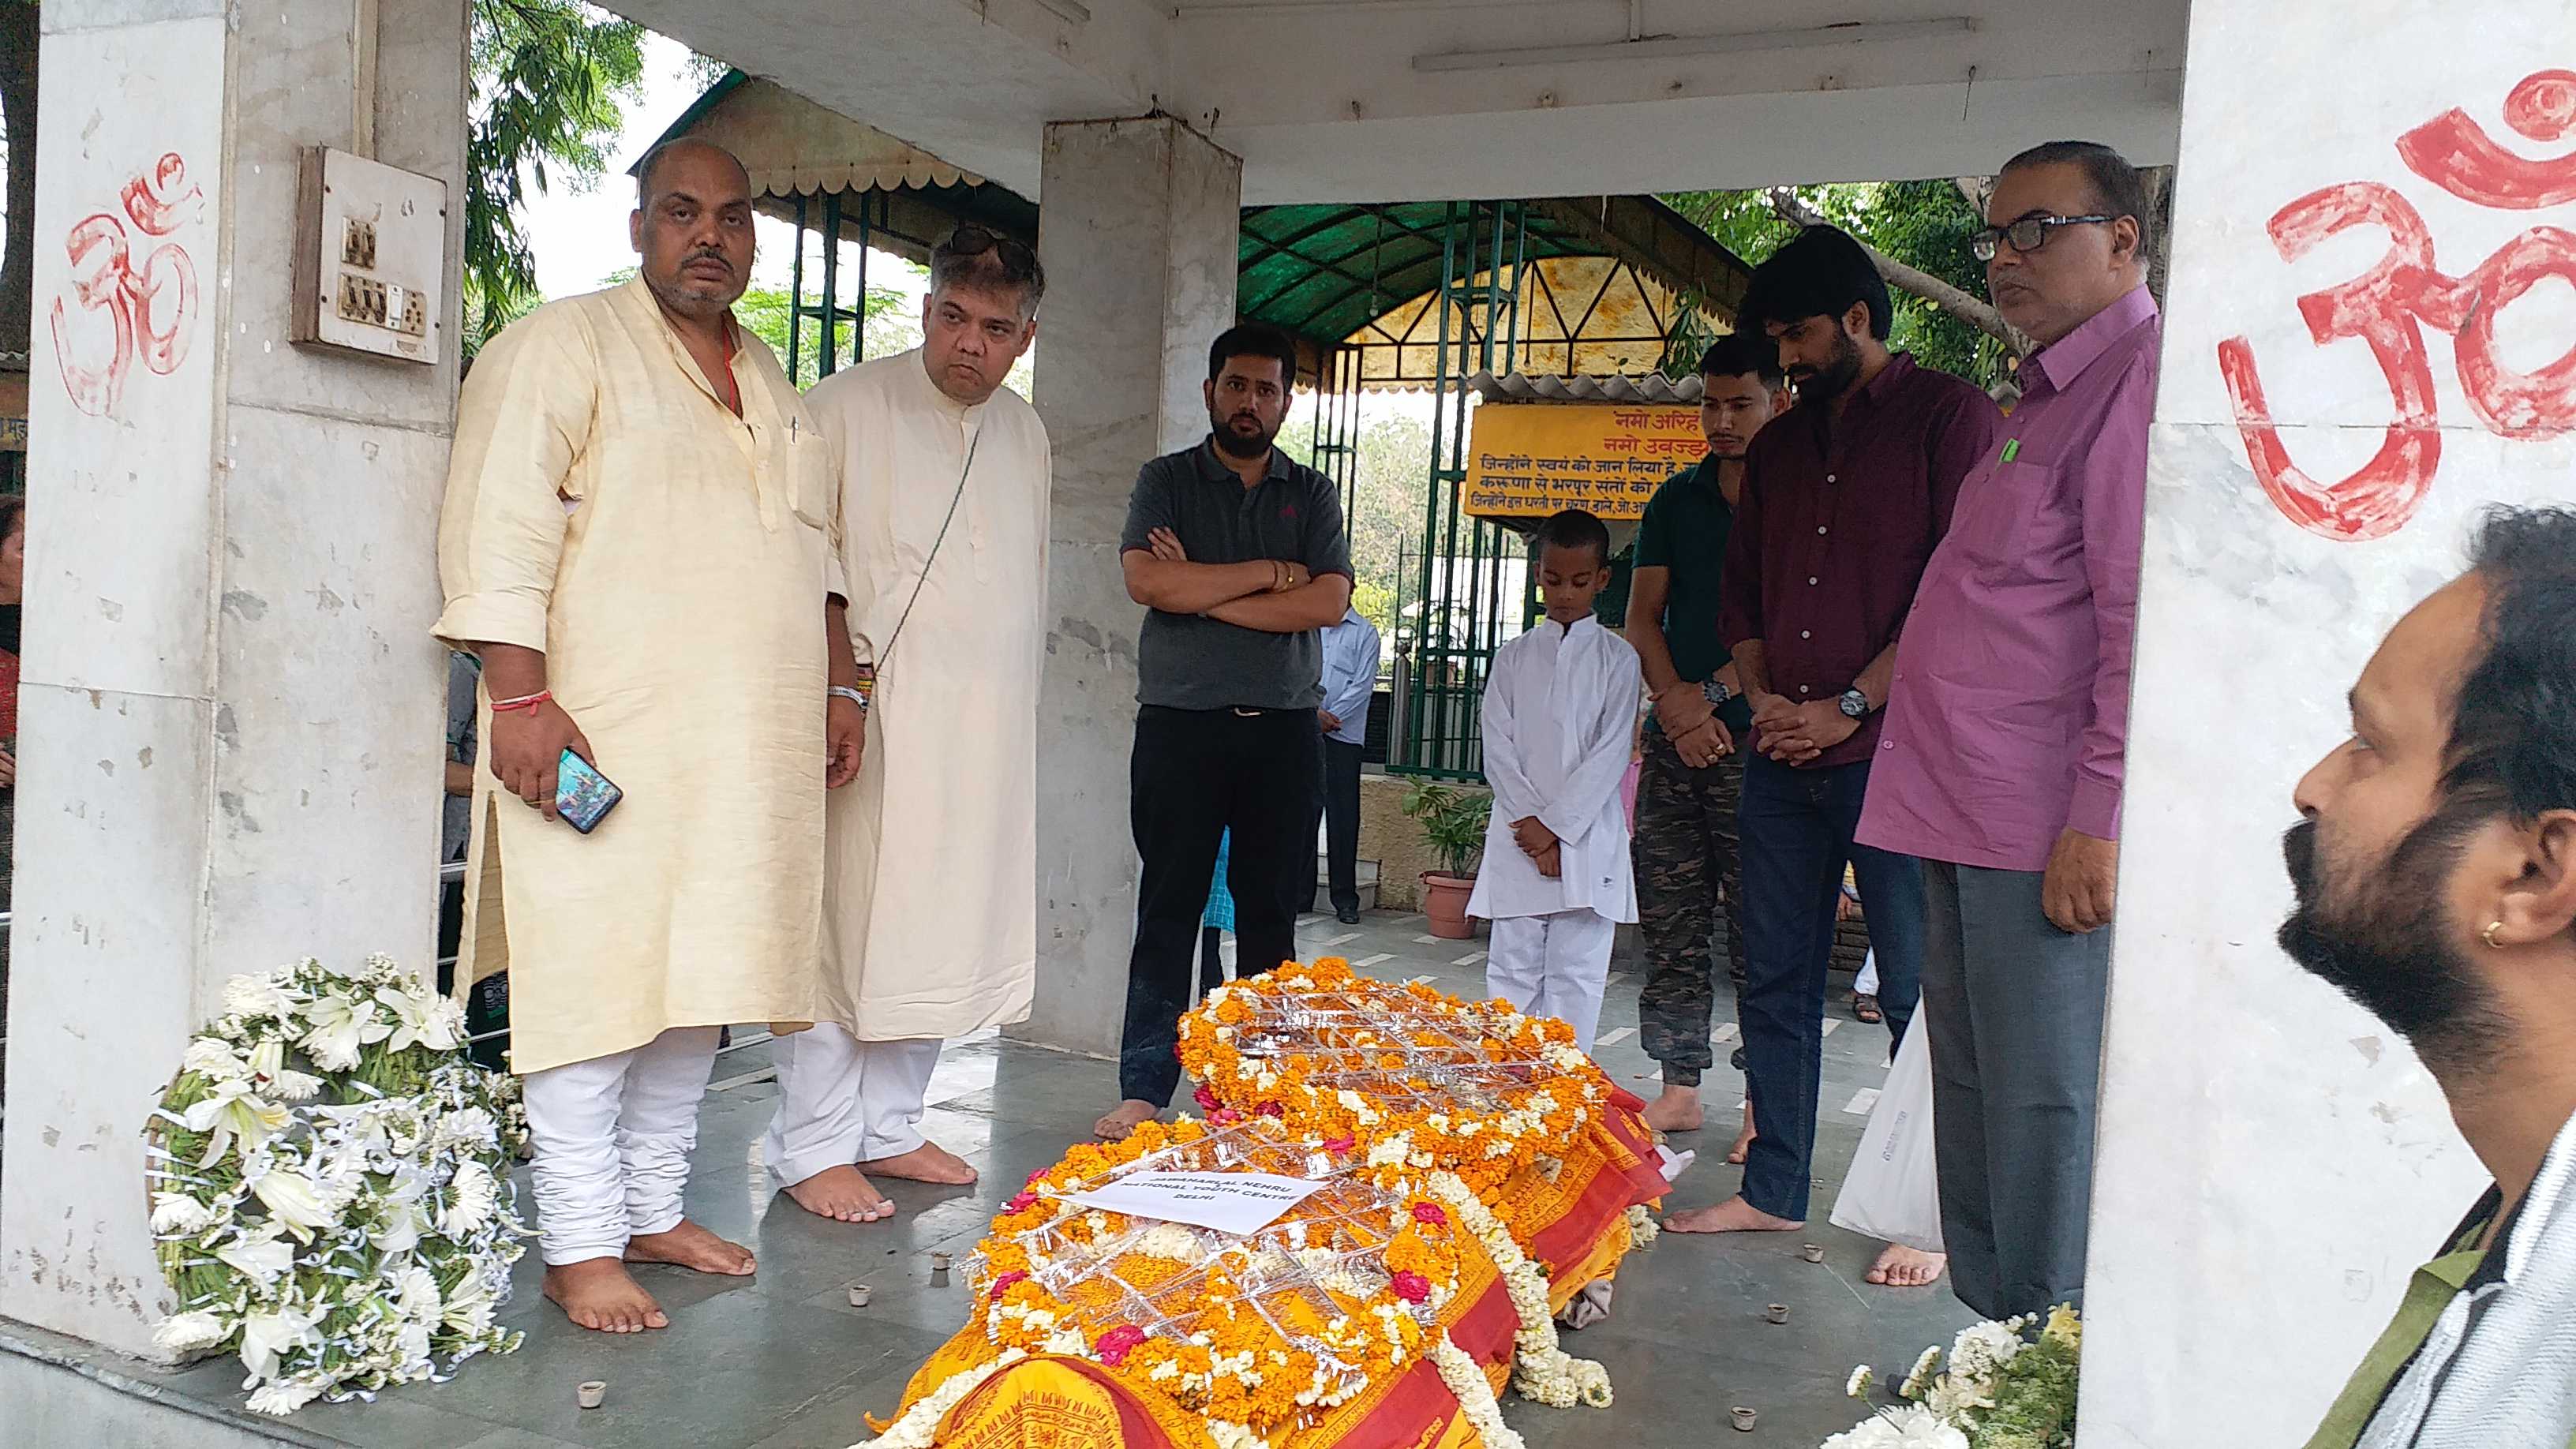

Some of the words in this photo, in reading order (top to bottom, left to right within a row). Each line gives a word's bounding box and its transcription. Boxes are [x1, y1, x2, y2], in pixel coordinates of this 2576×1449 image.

[1615, 409, 1651, 429] नमो
[1604, 434, 1641, 453] नमो
[1537, 455, 1570, 472] स्वयं
[1572, 455, 1592, 472] को
[1593, 459, 1623, 473] जान
[1627, 456, 1663, 476] लिया
[1534, 474, 1549, 492] से
[1552, 477, 1592, 496] भरपूर
[1596, 477, 1627, 496] संतों
[1630, 477, 1653, 495] को
[1193, 1185, 1240, 1194] YOUTH
[1242, 1190, 1300, 1201] CENTRE
[1241, 1181, 1293, 1193] NEHRU
